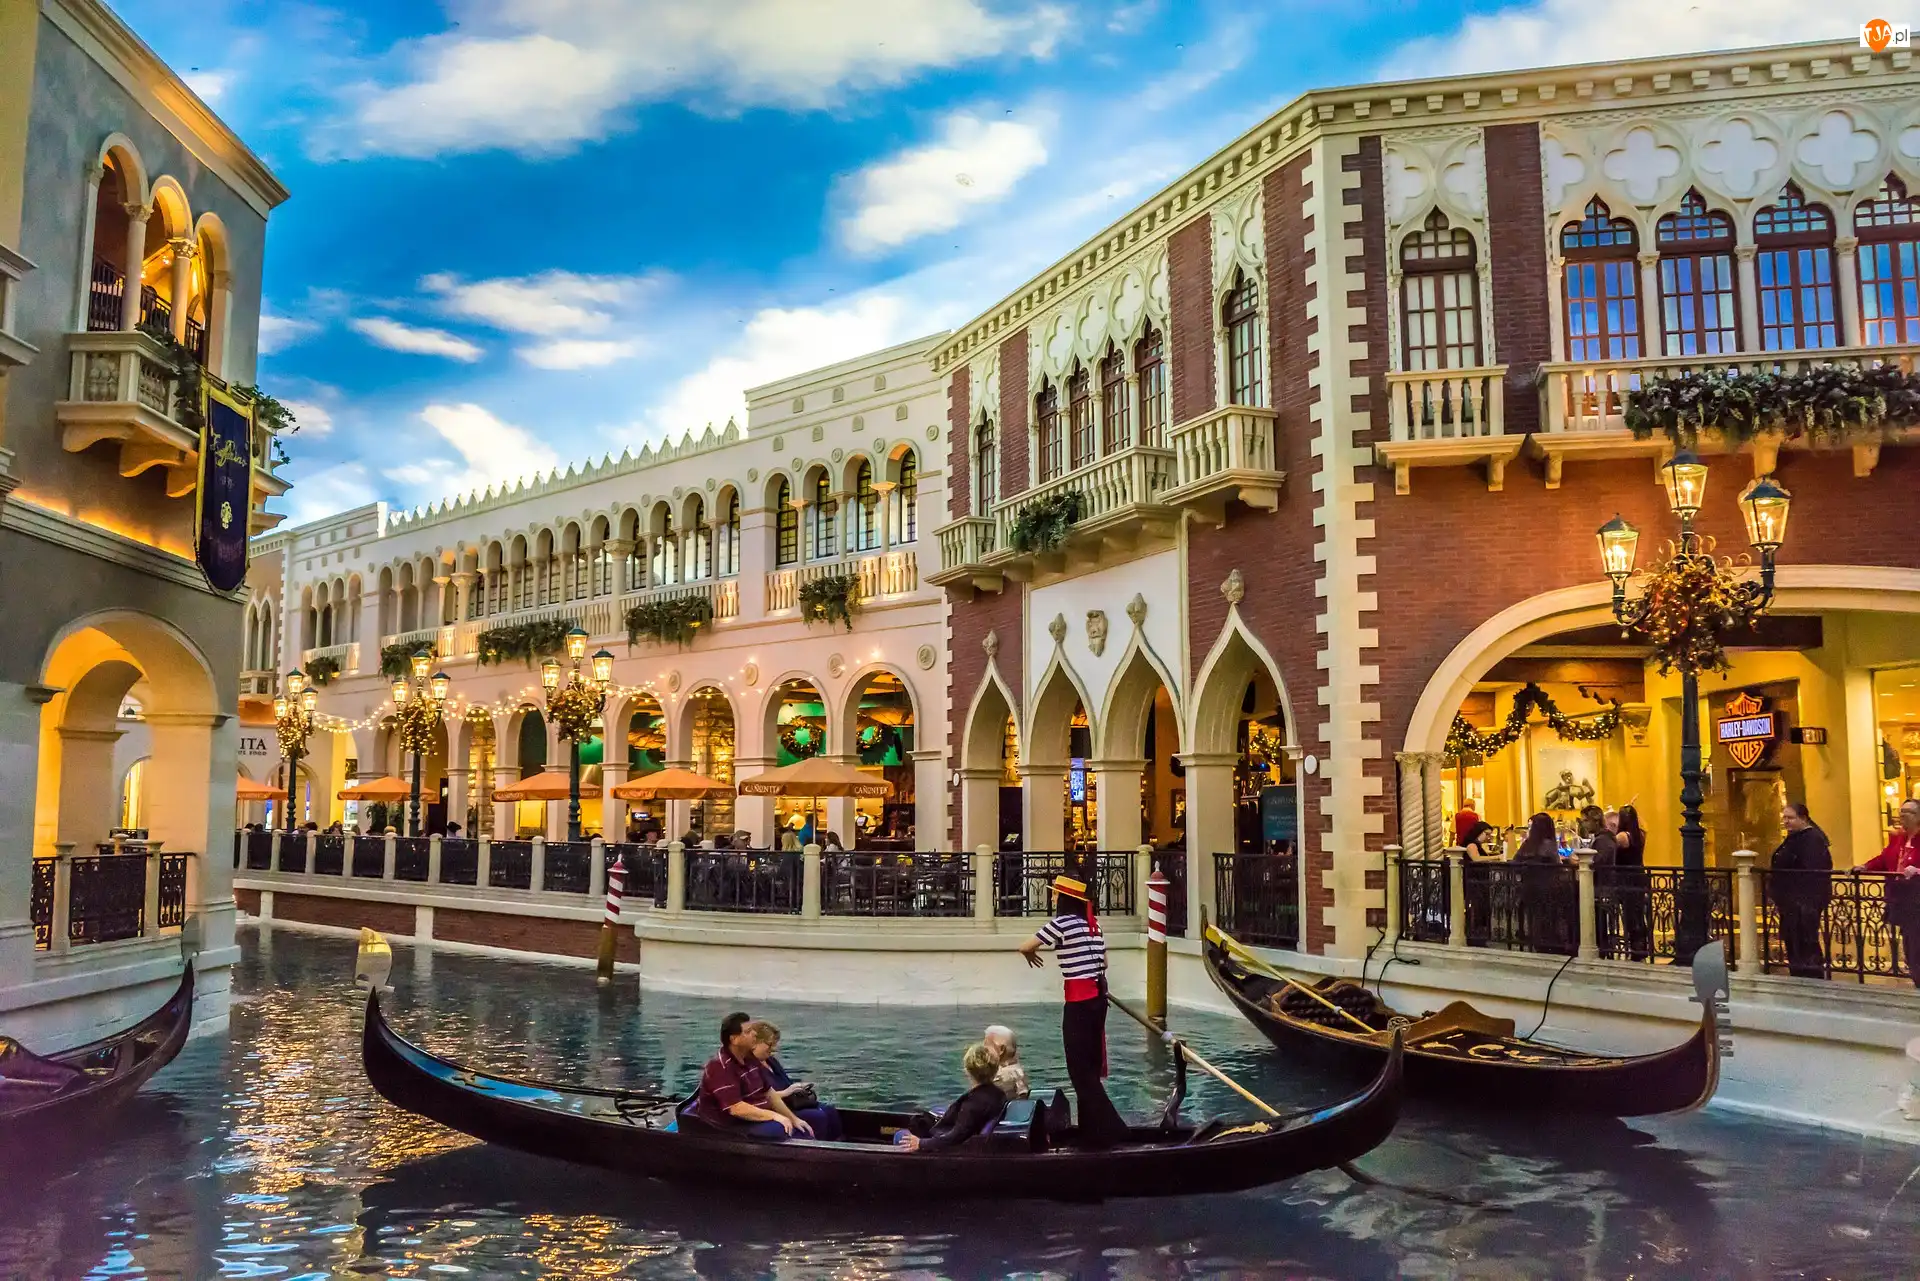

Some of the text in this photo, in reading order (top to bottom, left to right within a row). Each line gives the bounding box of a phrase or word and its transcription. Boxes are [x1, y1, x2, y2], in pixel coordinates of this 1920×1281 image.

[1720, 718, 1771, 738] HARLEY-DAVIDSON
[240, 737, 266, 750] ITA
[1732, 741, 1760, 763] CYCLES
